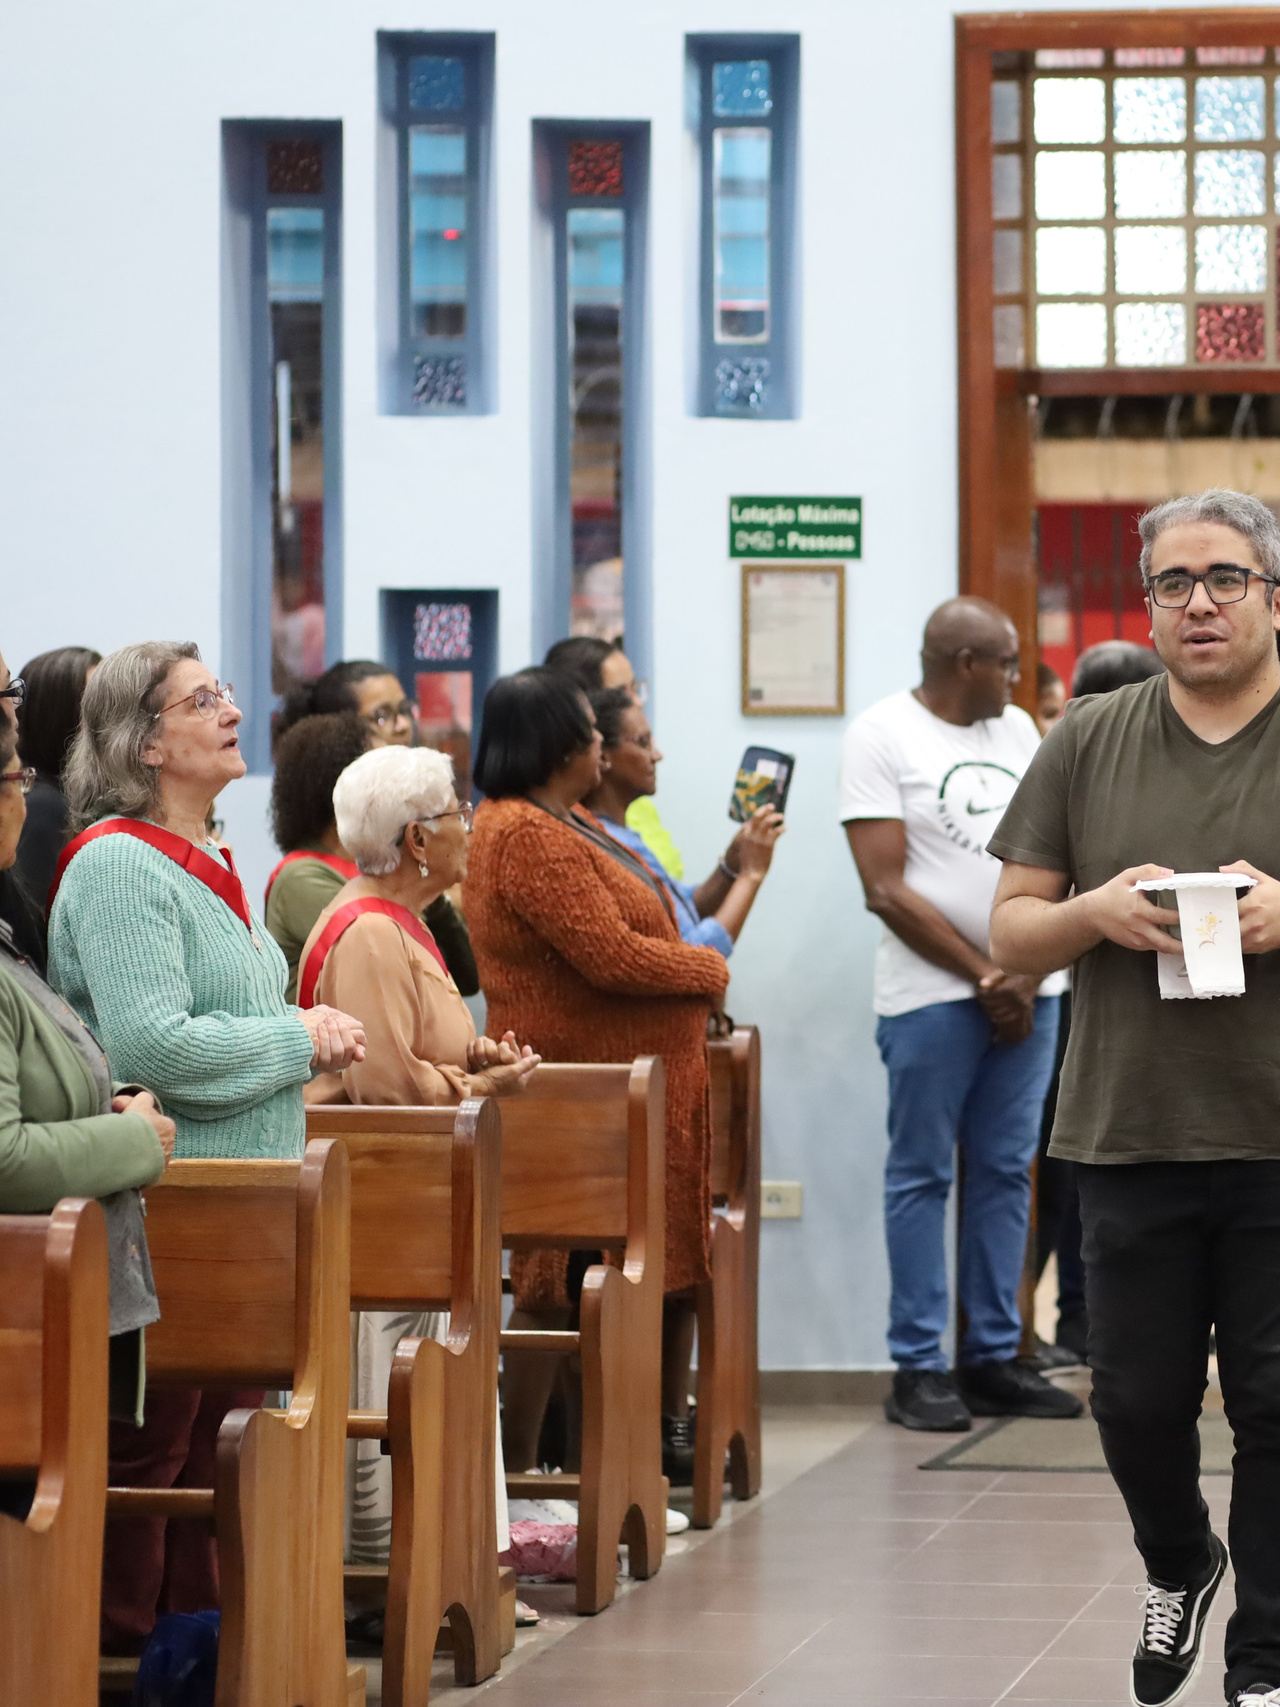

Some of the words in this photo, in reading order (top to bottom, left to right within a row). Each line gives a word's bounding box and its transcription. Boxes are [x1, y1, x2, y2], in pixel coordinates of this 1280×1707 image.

[731, 503, 796, 527] Lotação
[798, 503, 860, 524] Máxima
[787, 530, 856, 551] Pessoas
